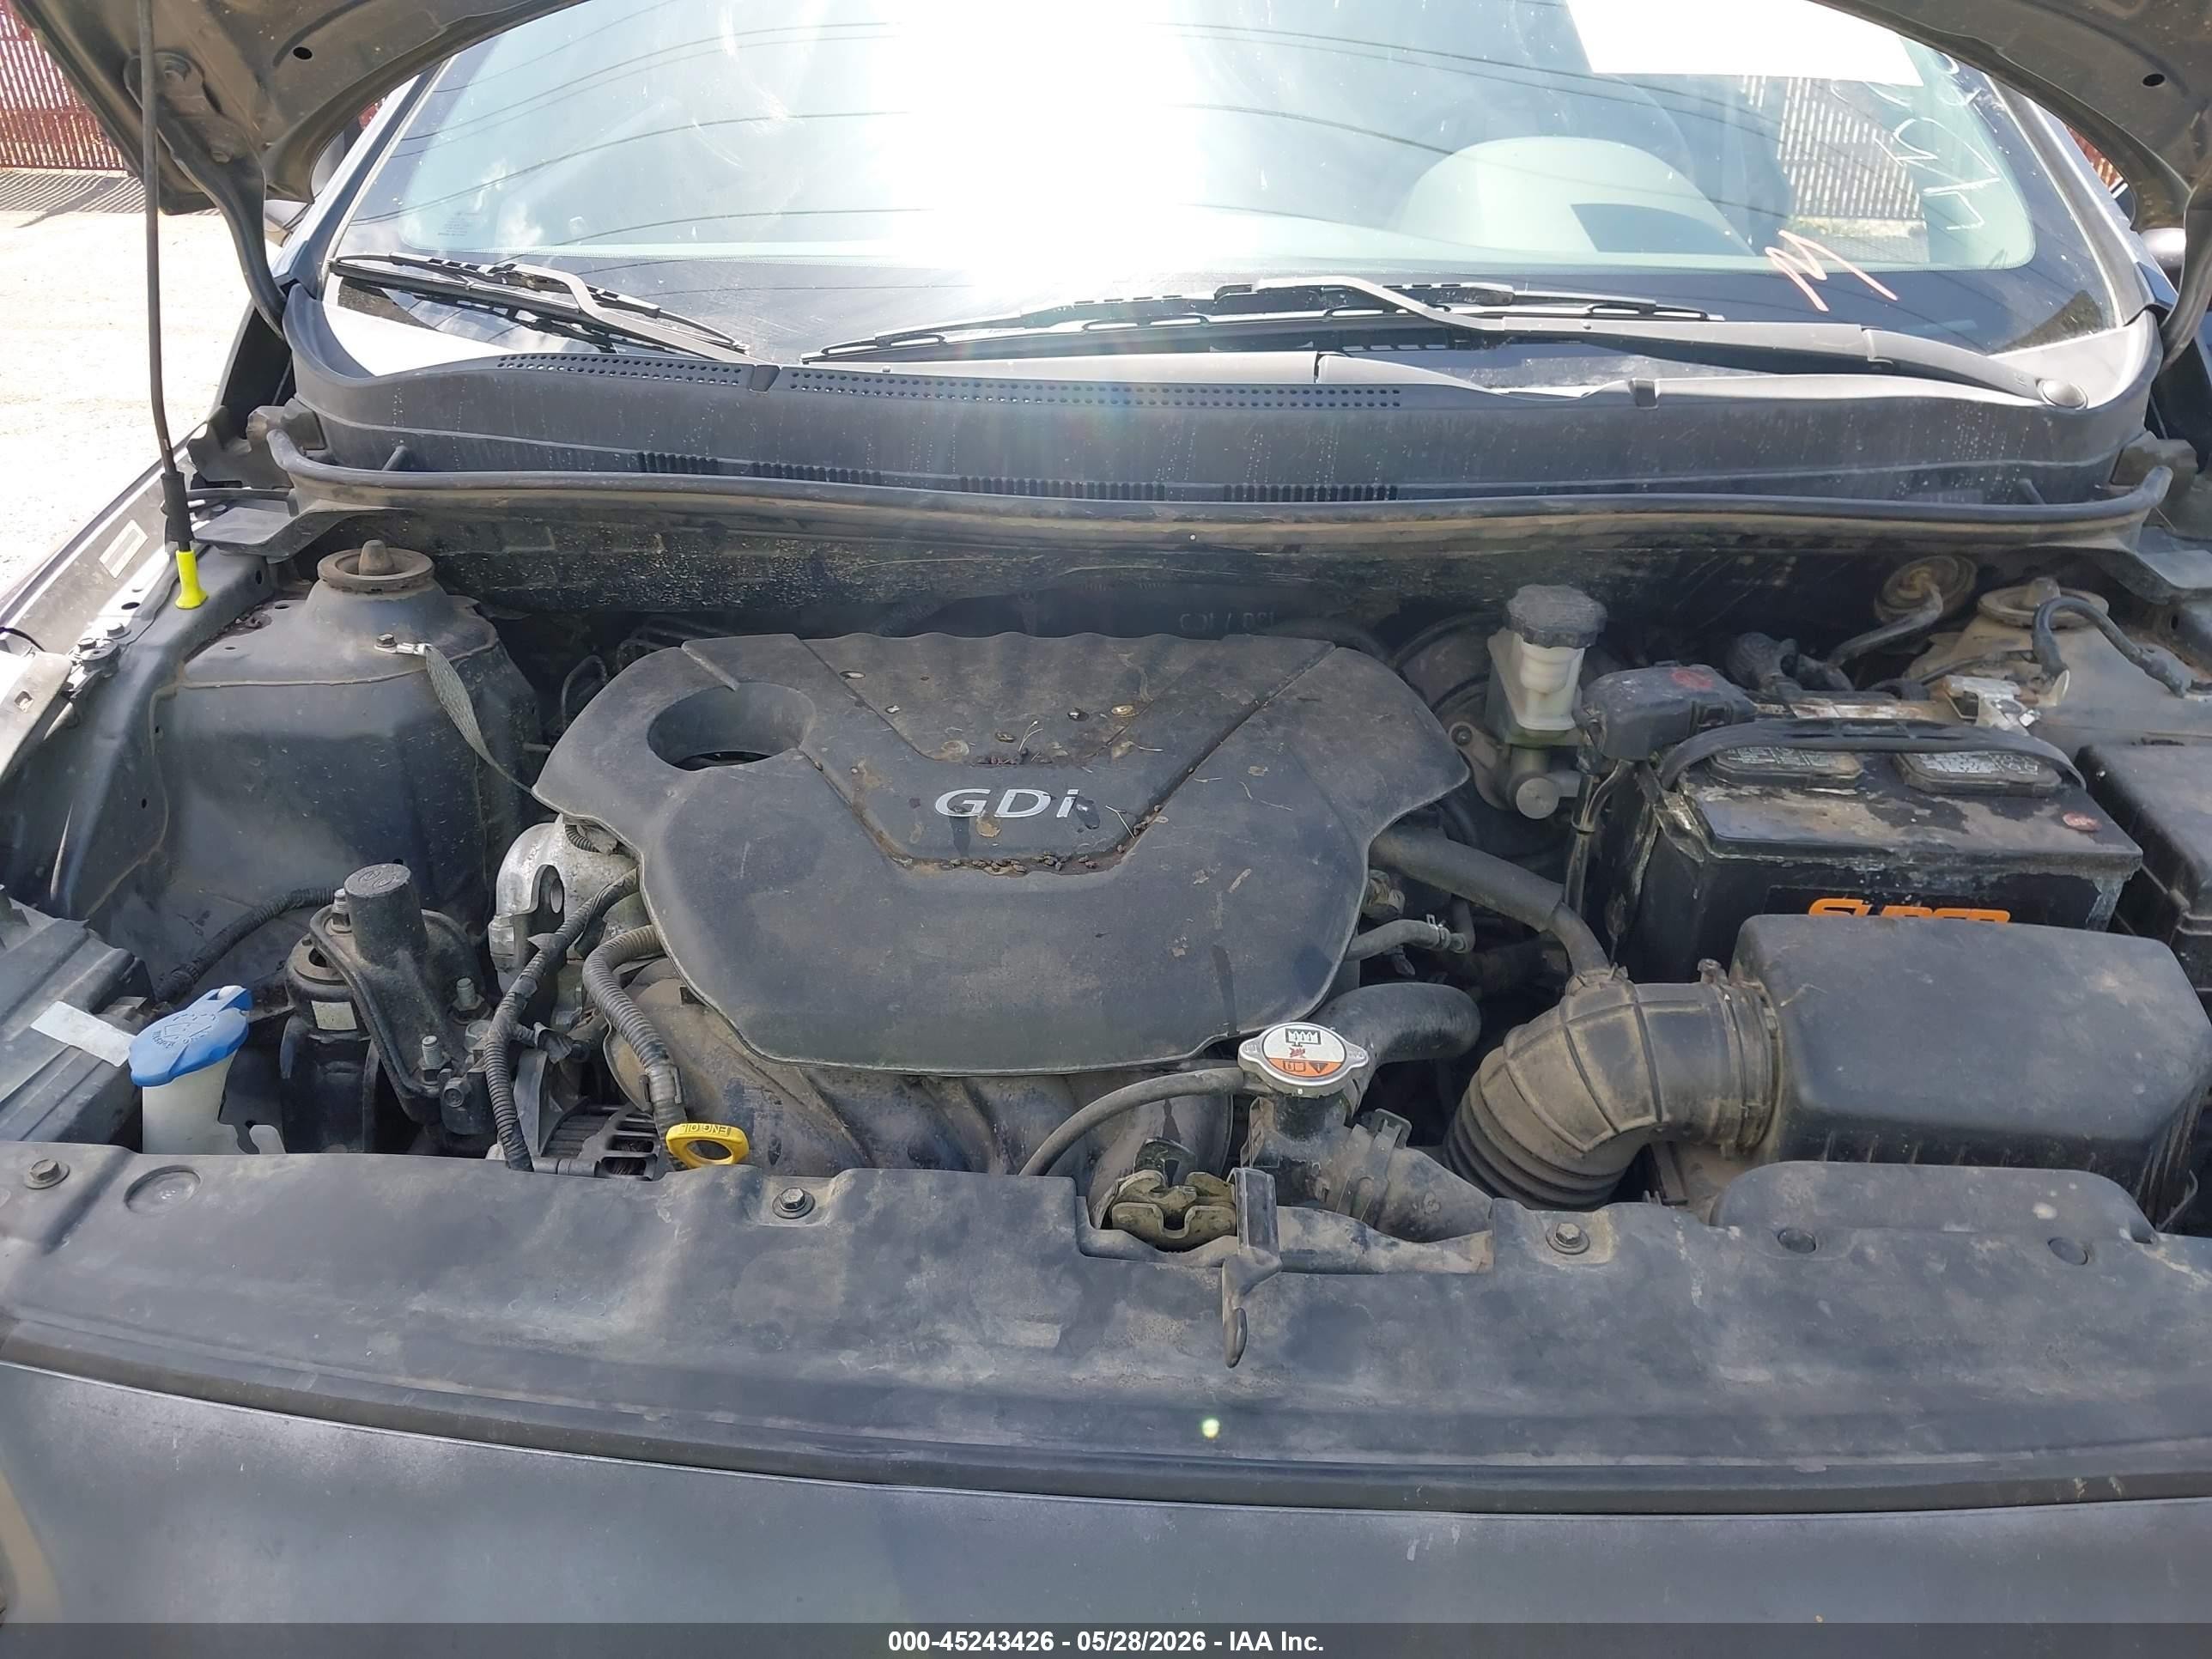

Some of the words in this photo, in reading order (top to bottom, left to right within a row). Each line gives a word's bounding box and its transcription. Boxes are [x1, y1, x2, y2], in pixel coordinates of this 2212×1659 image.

[935, 788, 1079, 818] GDi
[682, 1123, 699, 1133] OIL
[704, 1123, 729, 1134] ENG
